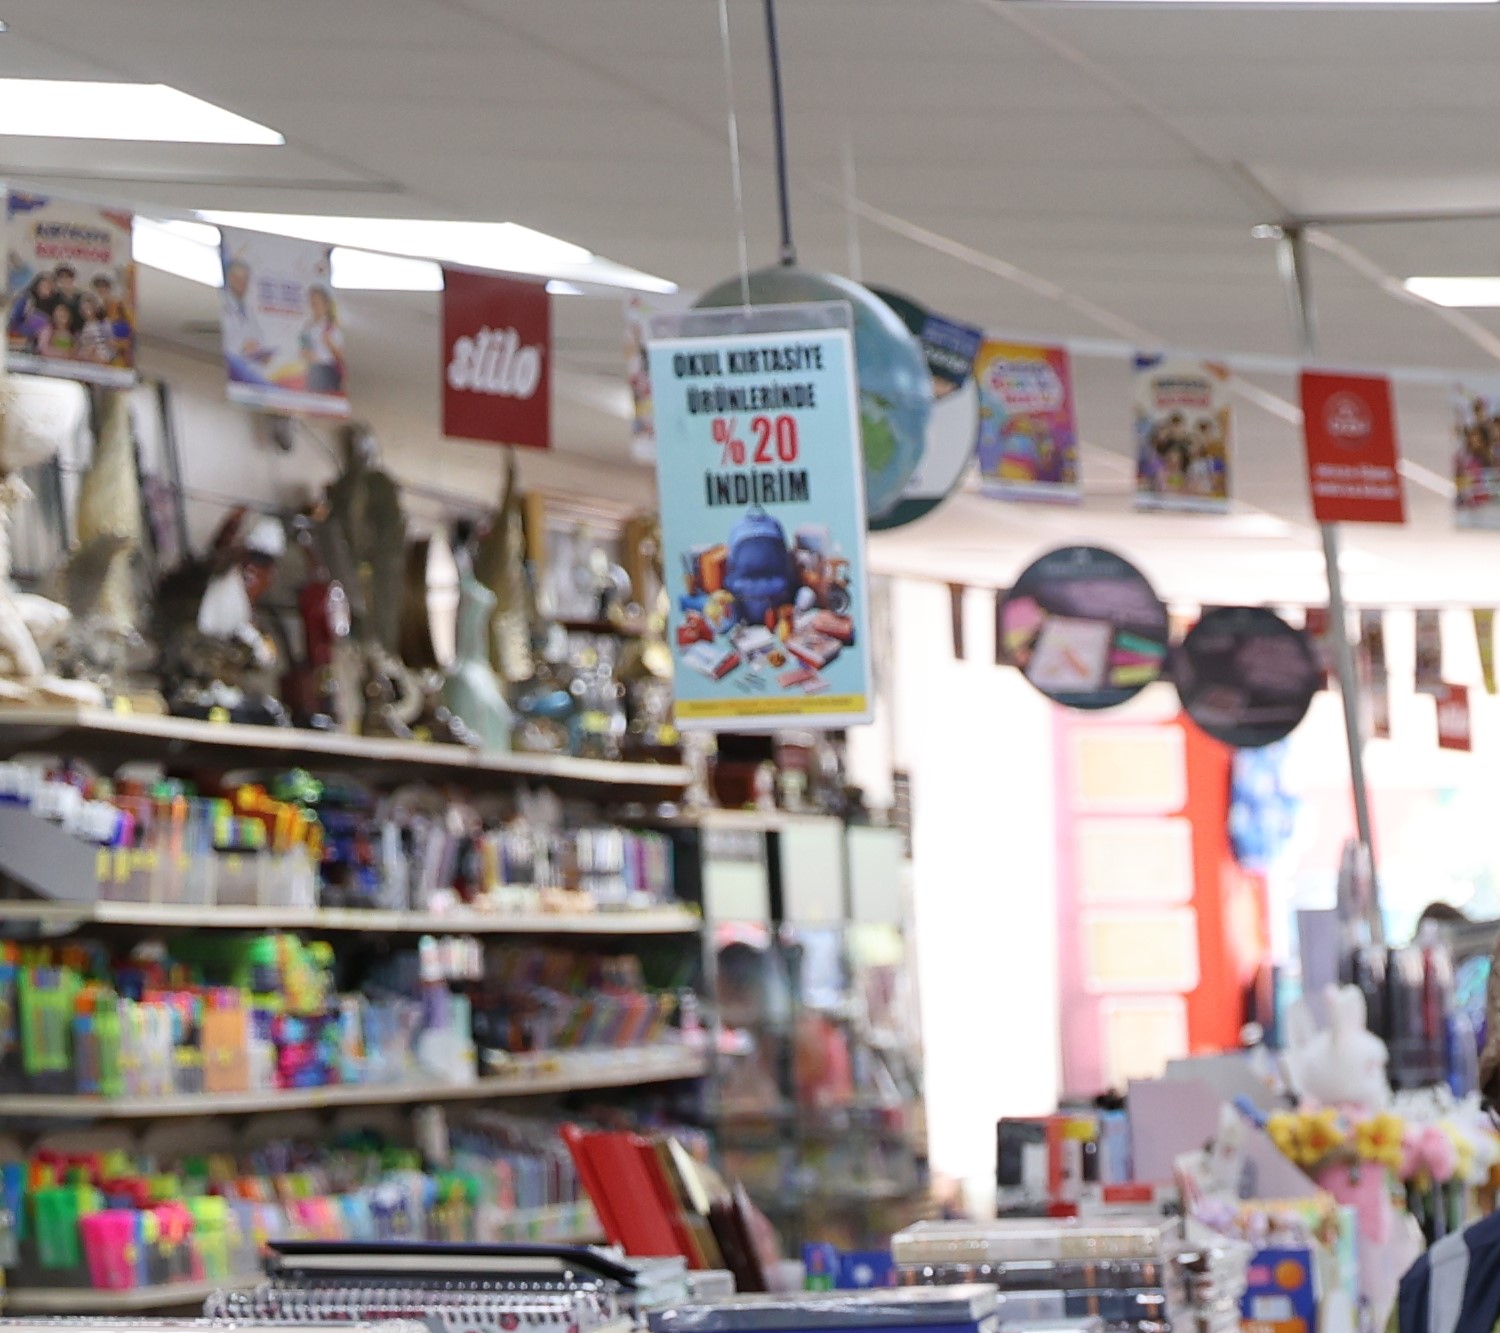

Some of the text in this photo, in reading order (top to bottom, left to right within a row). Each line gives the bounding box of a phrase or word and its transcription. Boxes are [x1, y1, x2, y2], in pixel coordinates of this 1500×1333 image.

[673, 342, 824, 379] OKUL KIRTASİYE
[687, 380, 816, 414] ÜRÜNLERİNDE
[705, 466, 810, 506] İNDİRİM
